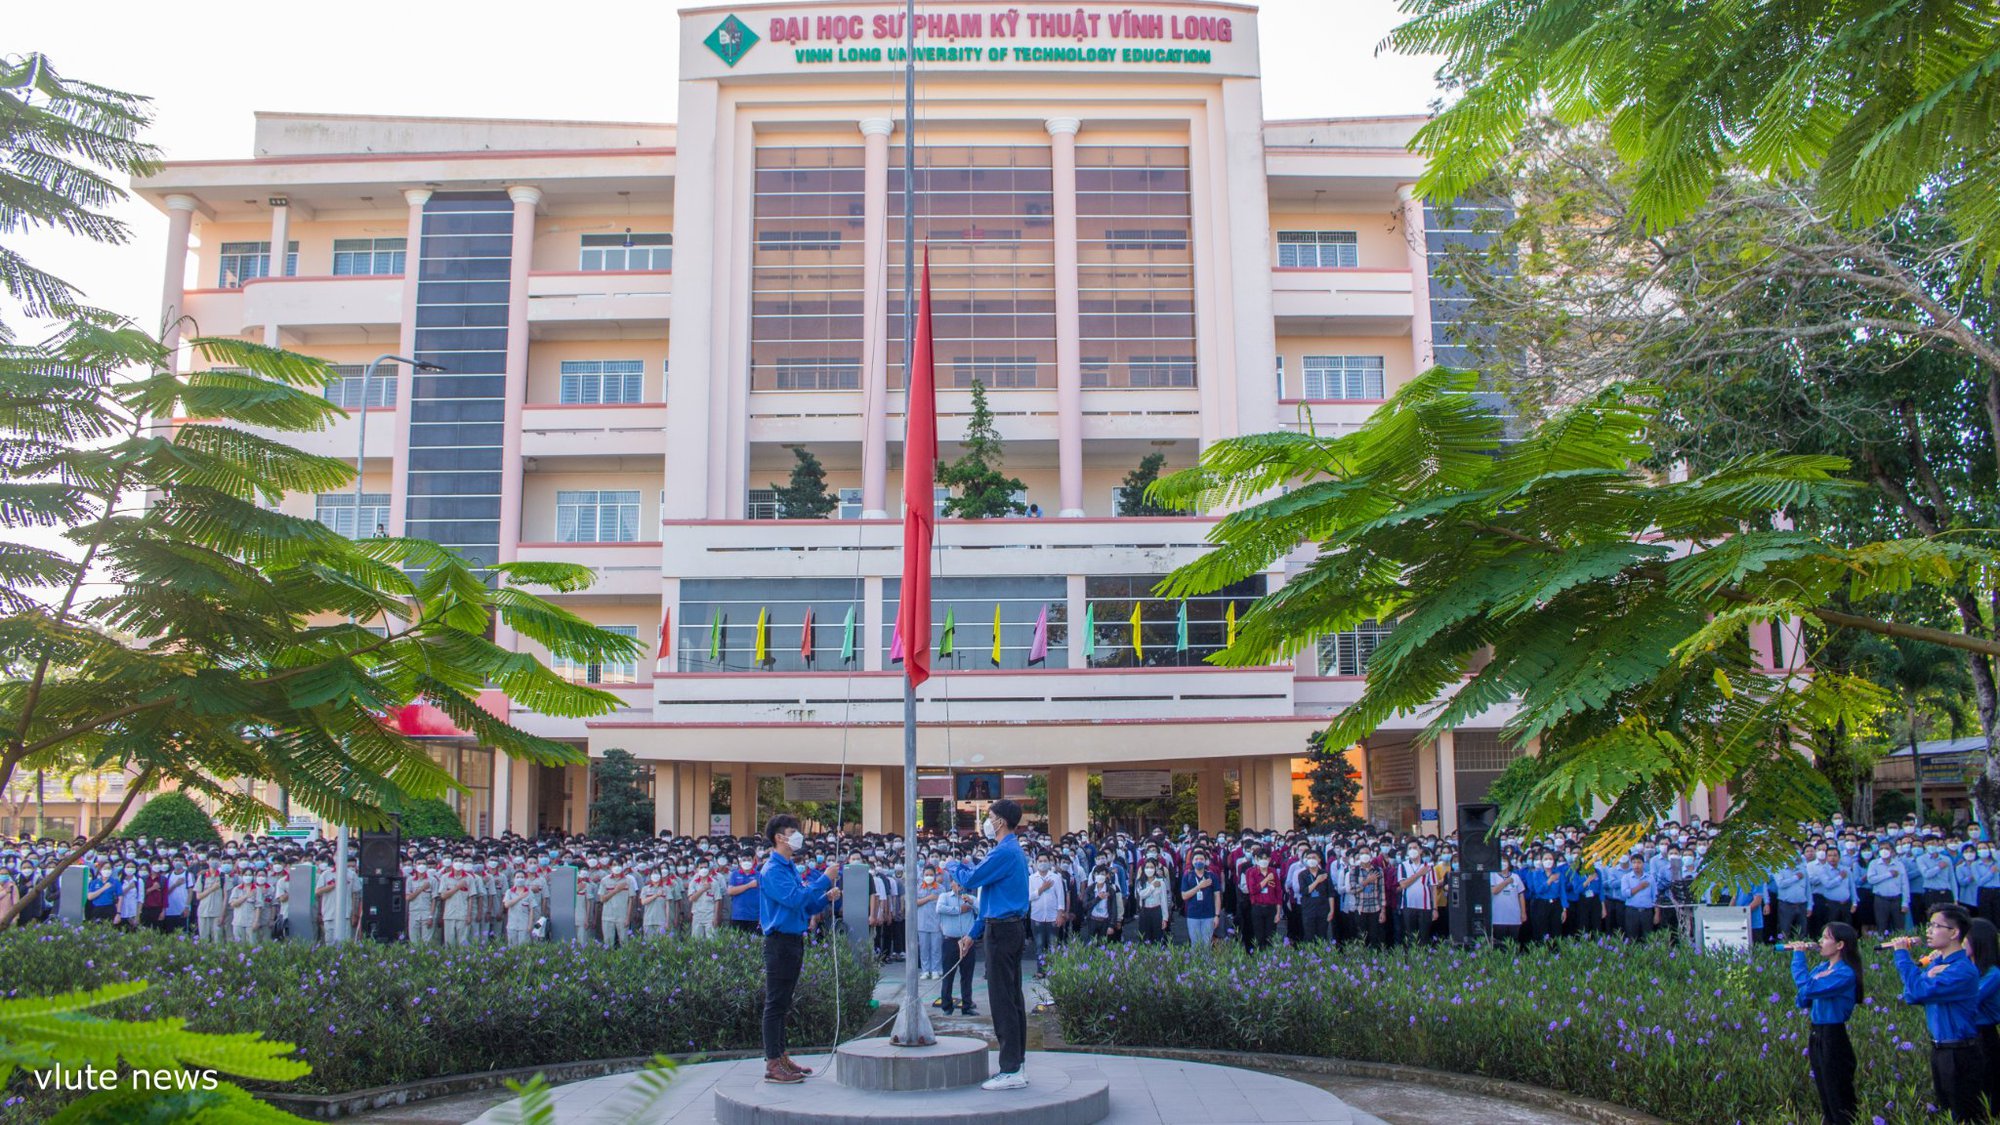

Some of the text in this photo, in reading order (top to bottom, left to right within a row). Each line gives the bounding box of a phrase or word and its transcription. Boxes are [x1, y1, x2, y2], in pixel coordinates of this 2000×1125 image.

[769, 8, 1232, 46] ĐẠI HỌC SƯ PHẠM KỸ THUẬT VĨNH LONG
[795, 48, 833, 63] VINH
[838, 47, 882, 62] LONG
[988, 46, 1008, 61] OF
[1012, 46, 1117, 62] TECHNOLOGY
[1122, 47, 1212, 63] EDUCATION
